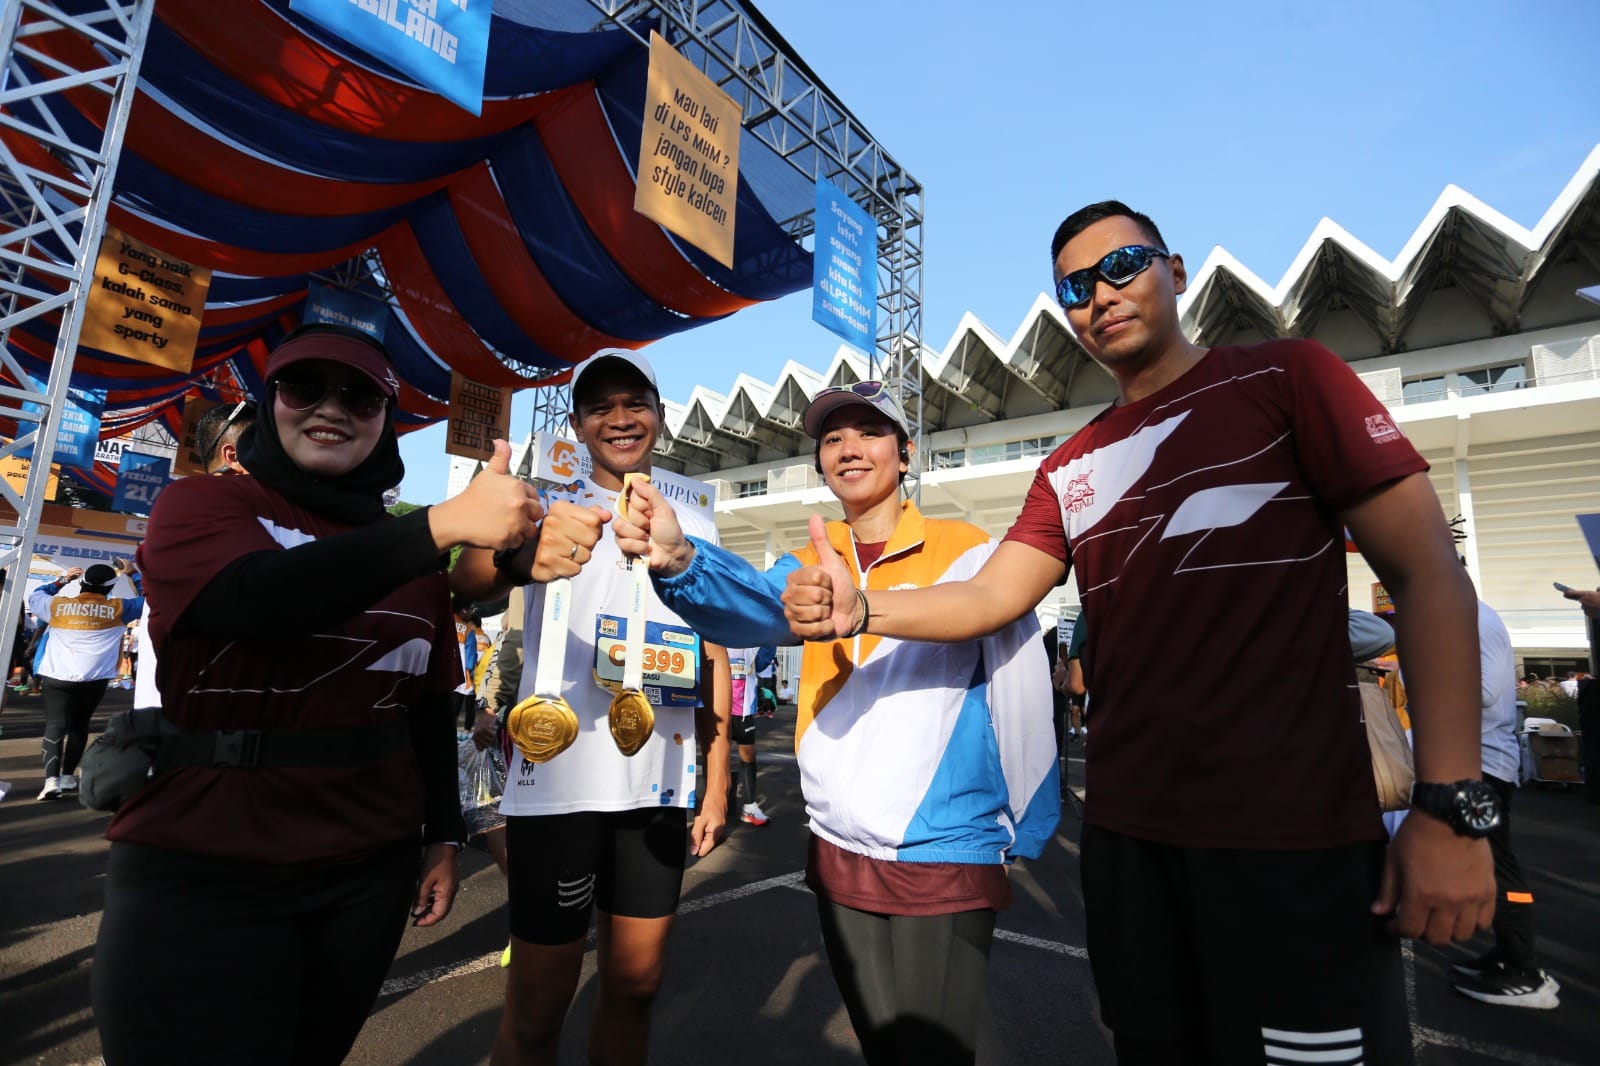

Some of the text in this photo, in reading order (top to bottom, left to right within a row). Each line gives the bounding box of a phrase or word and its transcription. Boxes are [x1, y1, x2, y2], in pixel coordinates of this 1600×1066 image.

[347, 0, 458, 64] ILANG
[673, 88, 720, 134] Mau lari
[654, 102, 671, 124] di
[670, 114, 691, 142] LPS
[692, 133, 721, 164] MHM
[653, 133, 725, 195] jangan lupa
[652, 164, 727, 226] style kalcer!
[830, 200, 864, 236] Sayang
[119, 242, 193, 278] Yang naik
[829, 236, 862, 267] sayang
[101, 277, 192, 315] kalah sama
[819, 278, 872, 320] di LPS MHM
[828, 266, 863, 298] kita lari
[122, 306, 163, 329] yang
[113, 323, 169, 349] sporty
[95, 452, 120, 461] ARATH
[97, 441, 131, 454] NA
[652, 480, 699, 505] OMPAS
[55, 602, 115, 619] FINISHER
[642, 672, 660, 681] ZASU
